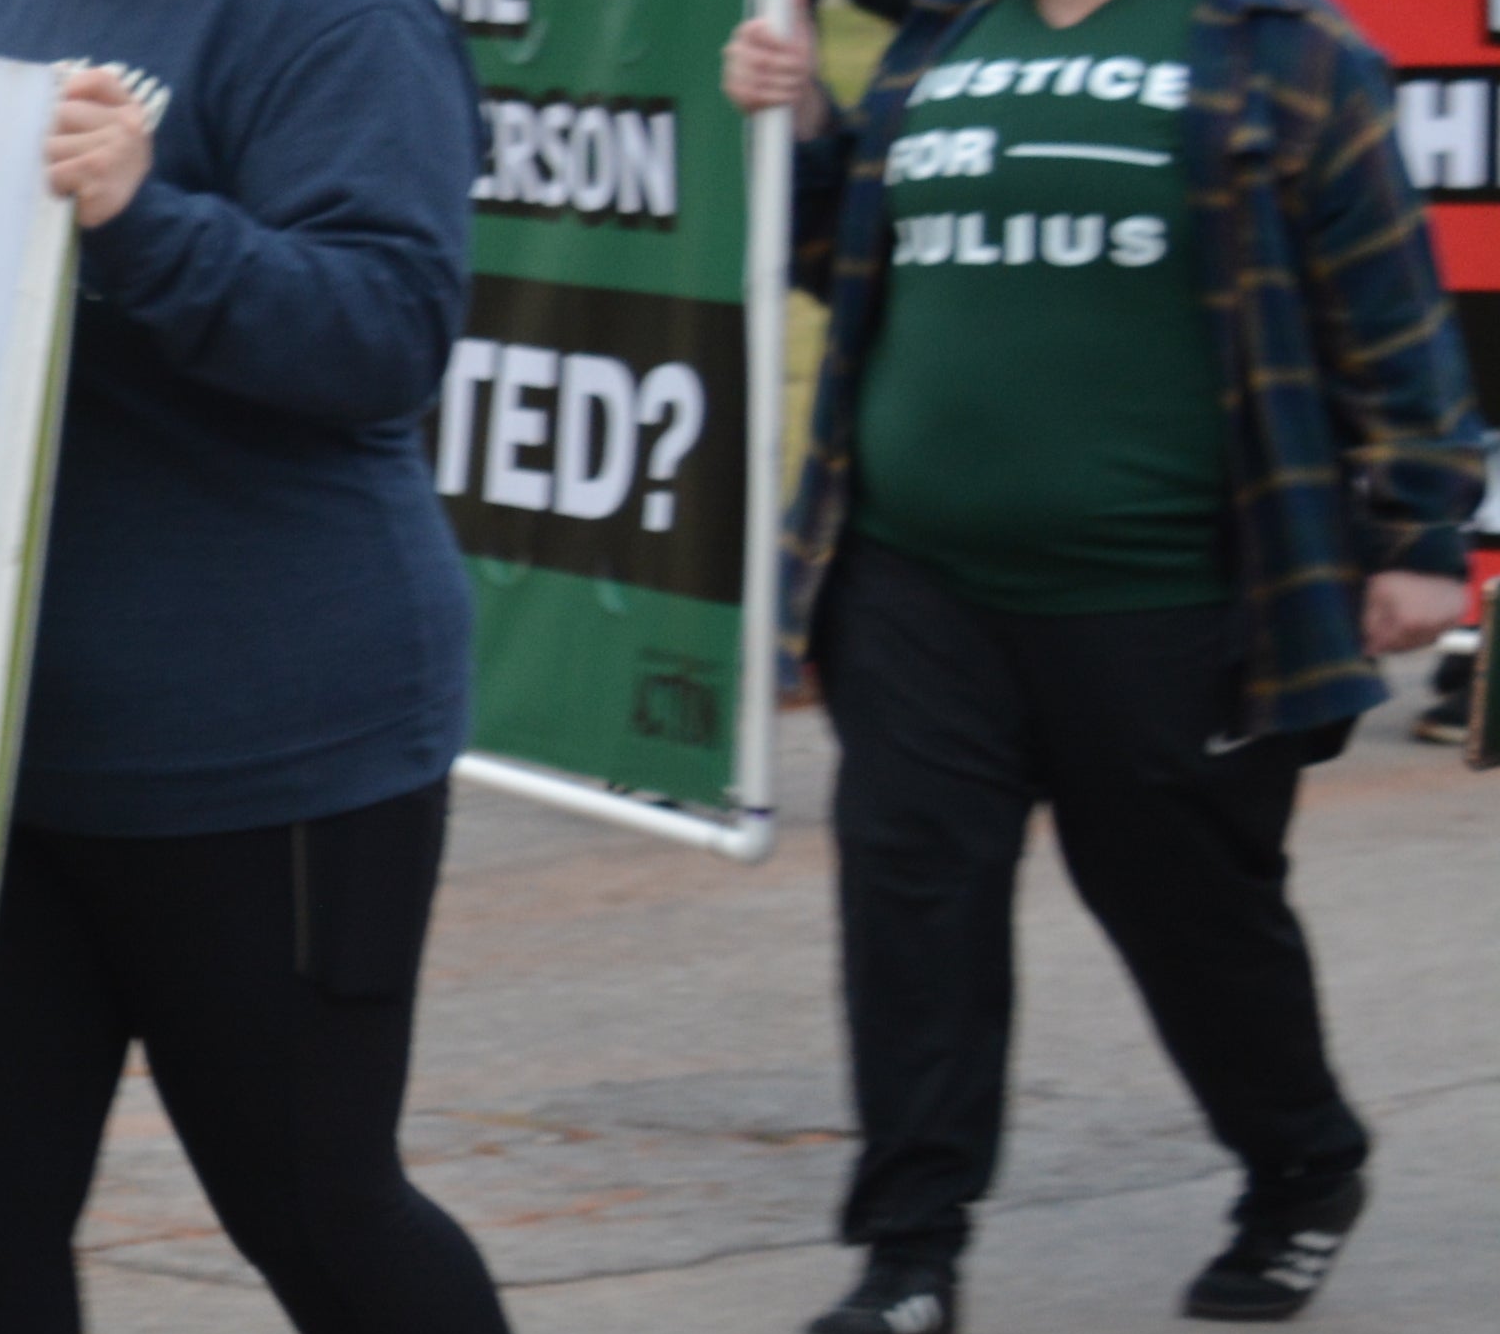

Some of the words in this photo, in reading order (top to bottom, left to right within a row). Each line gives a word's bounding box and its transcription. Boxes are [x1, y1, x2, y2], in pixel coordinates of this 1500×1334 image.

[468, 99, 676, 217] RSON
[884, 126, 998, 186] FOR
[436, 336, 706, 533] TED?
